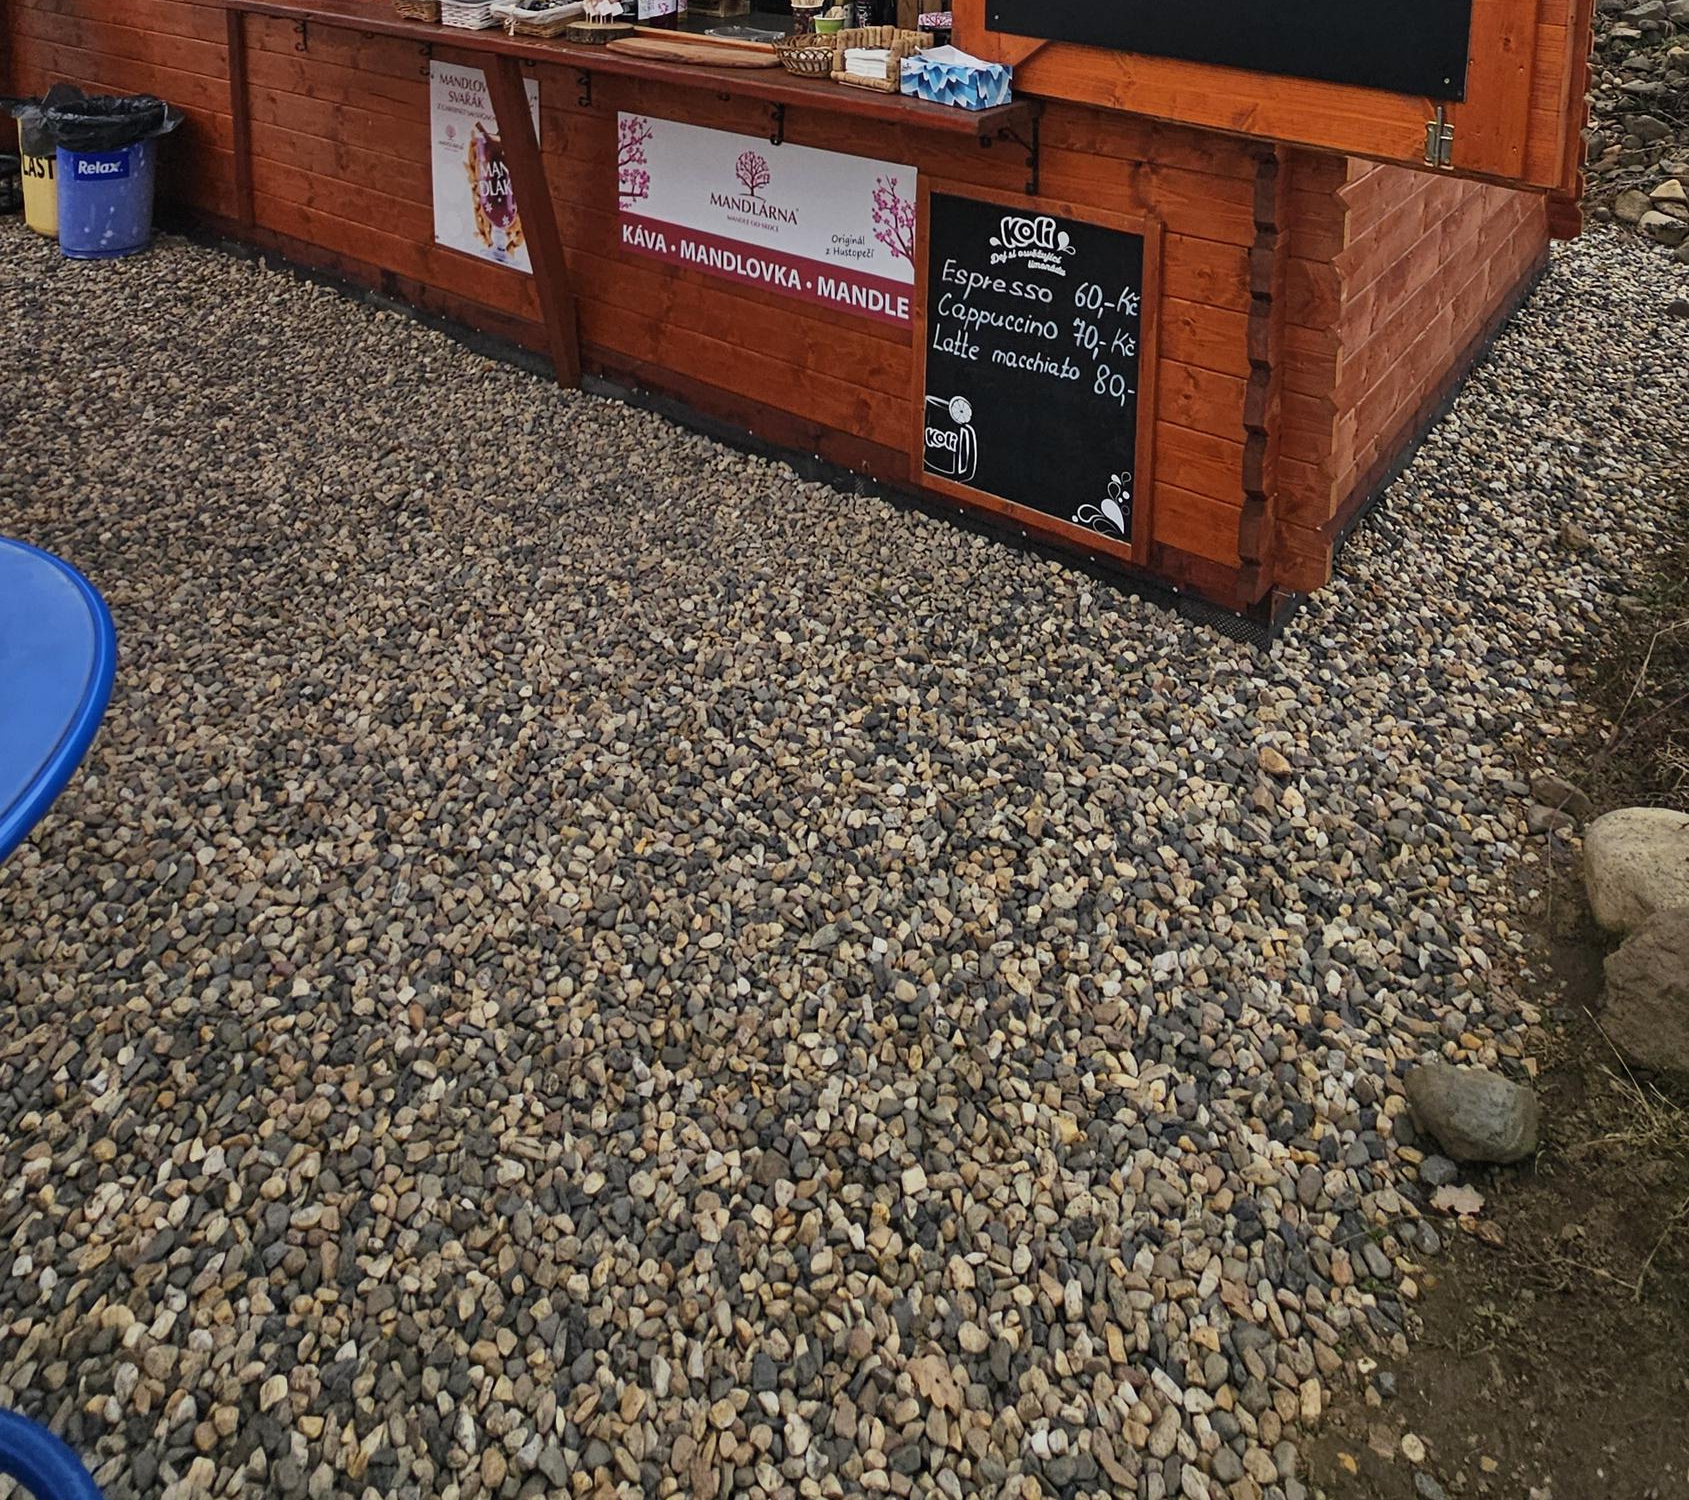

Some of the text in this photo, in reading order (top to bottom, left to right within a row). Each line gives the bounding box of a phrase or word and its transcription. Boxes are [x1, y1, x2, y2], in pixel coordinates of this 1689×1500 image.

[439, 73, 487, 93] MANDLOV
[78, 160, 122, 175] Relax
[709, 192, 798, 225] MANDLÁRNA
[831, 234, 865, 247] Originál
[622, 224, 909, 319] KÁVA MANDLOVKA MANDLE
[941, 259, 1053, 303] Espresso
[937, 293, 1059, 340] Cappuccino
[933, 323, 980, 361] Latte
[992, 349, 1080, 380] macchiato
